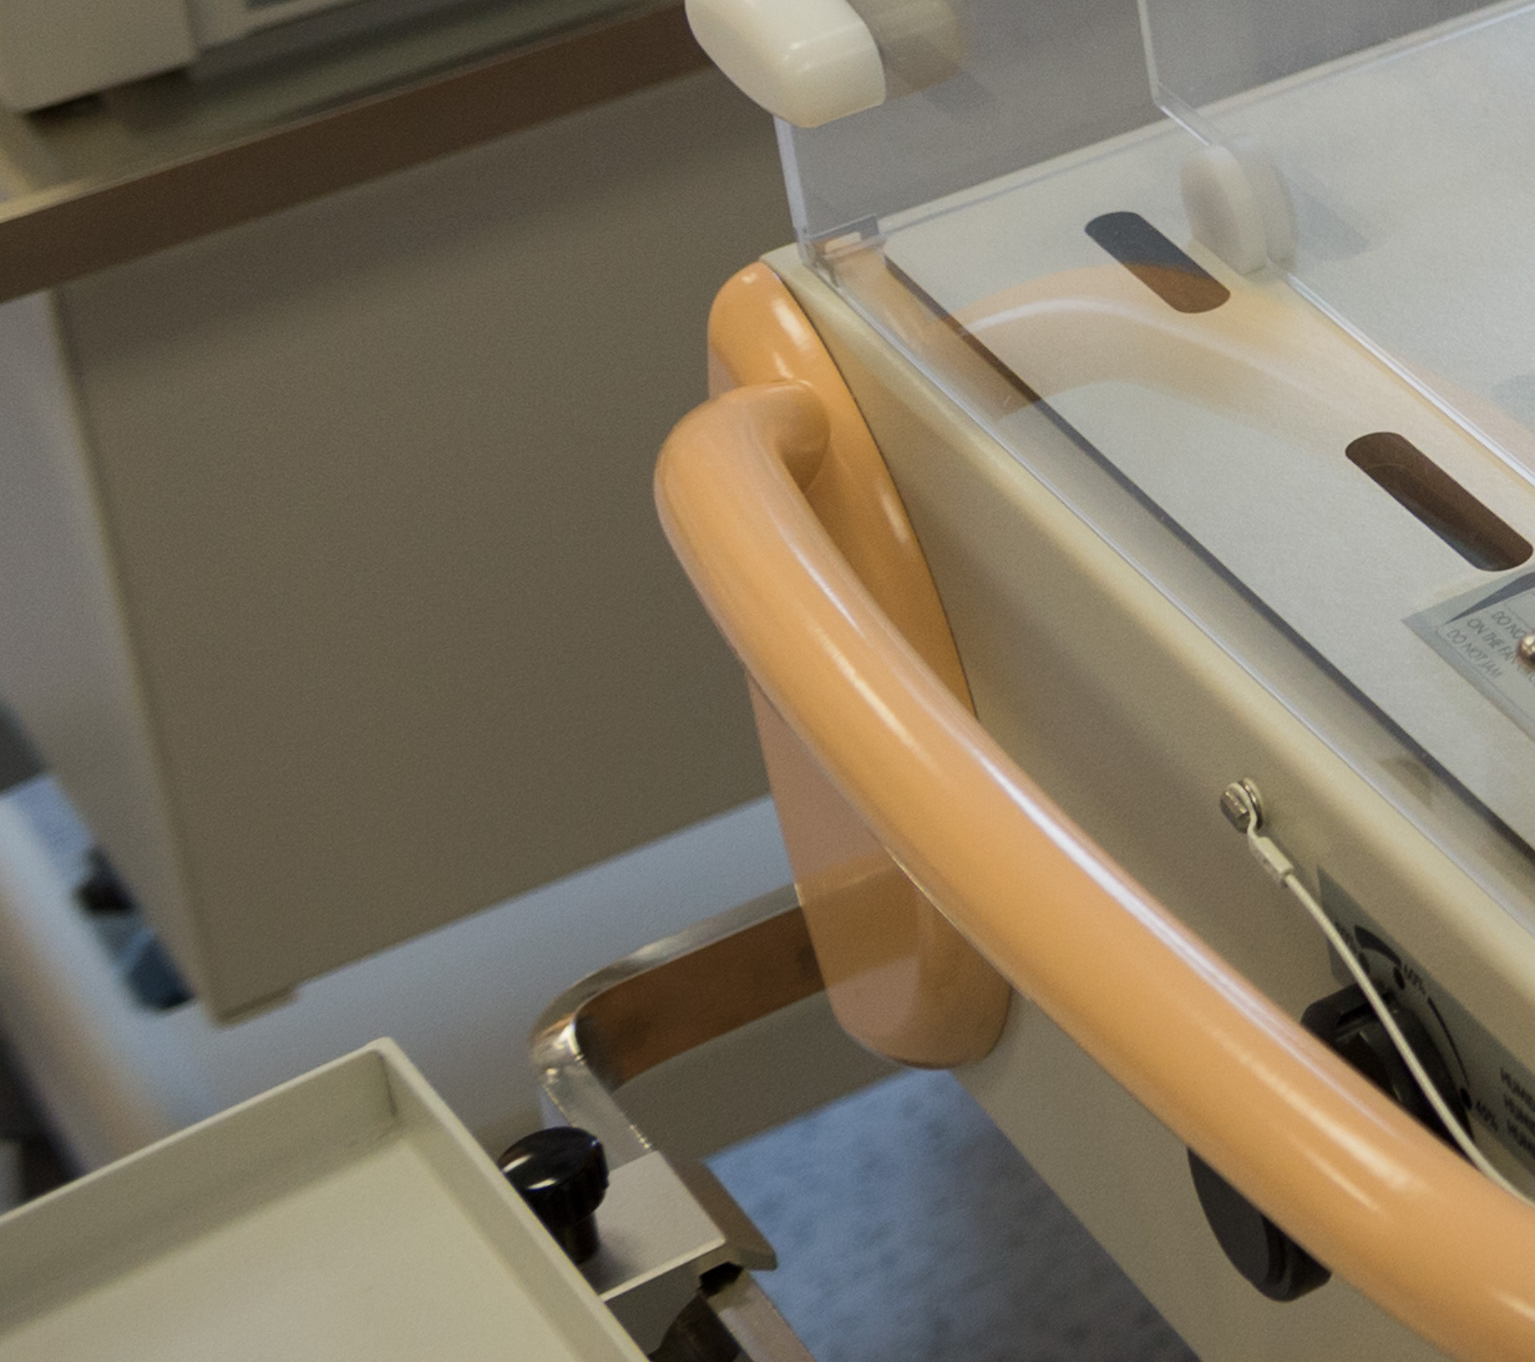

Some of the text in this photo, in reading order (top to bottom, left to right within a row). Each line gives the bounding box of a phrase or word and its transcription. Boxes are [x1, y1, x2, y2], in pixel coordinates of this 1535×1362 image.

[1463, 616, 1491, 635] ON
[1479, 631, 1507, 649] THE
[1487, 610, 1515, 627] DO
[1444, 628, 1507, 678] DO NOT JAM
